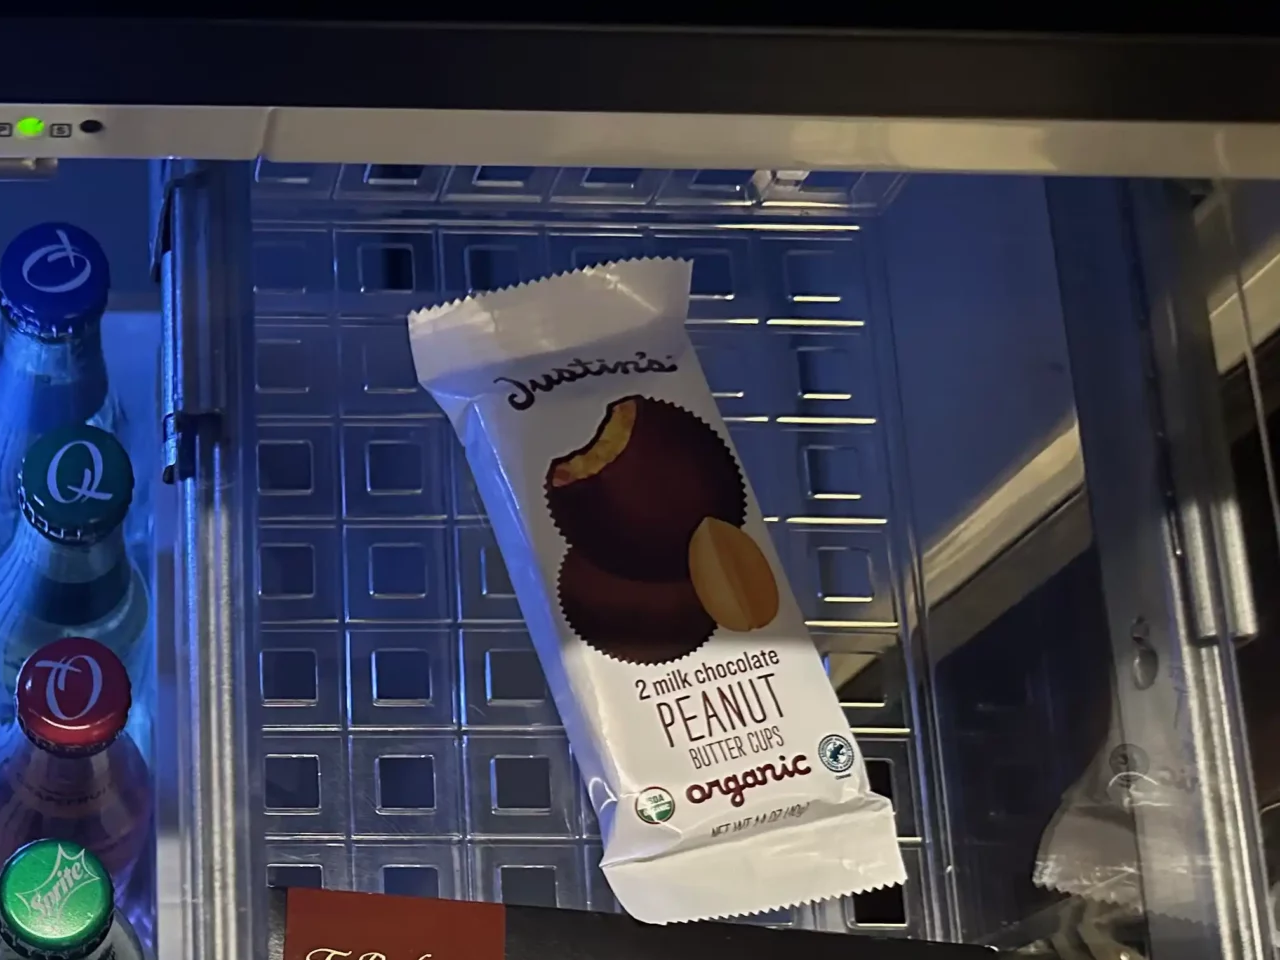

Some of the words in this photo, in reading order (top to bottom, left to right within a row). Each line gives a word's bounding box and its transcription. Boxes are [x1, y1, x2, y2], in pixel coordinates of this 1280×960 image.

[493, 351, 678, 411] Justin's
[46, 440, 114, 504] Q
[634, 679, 651, 701] 2
[652, 668, 693, 697] milk
[694, 649, 780, 685] chocolate
[655, 673, 784, 748] PEANUT
[689, 735, 747, 770] BUTTER
[746, 725, 785, 754] CUPS
[686, 754, 812, 808] organic
[30, 861, 84, 922] Sprite
